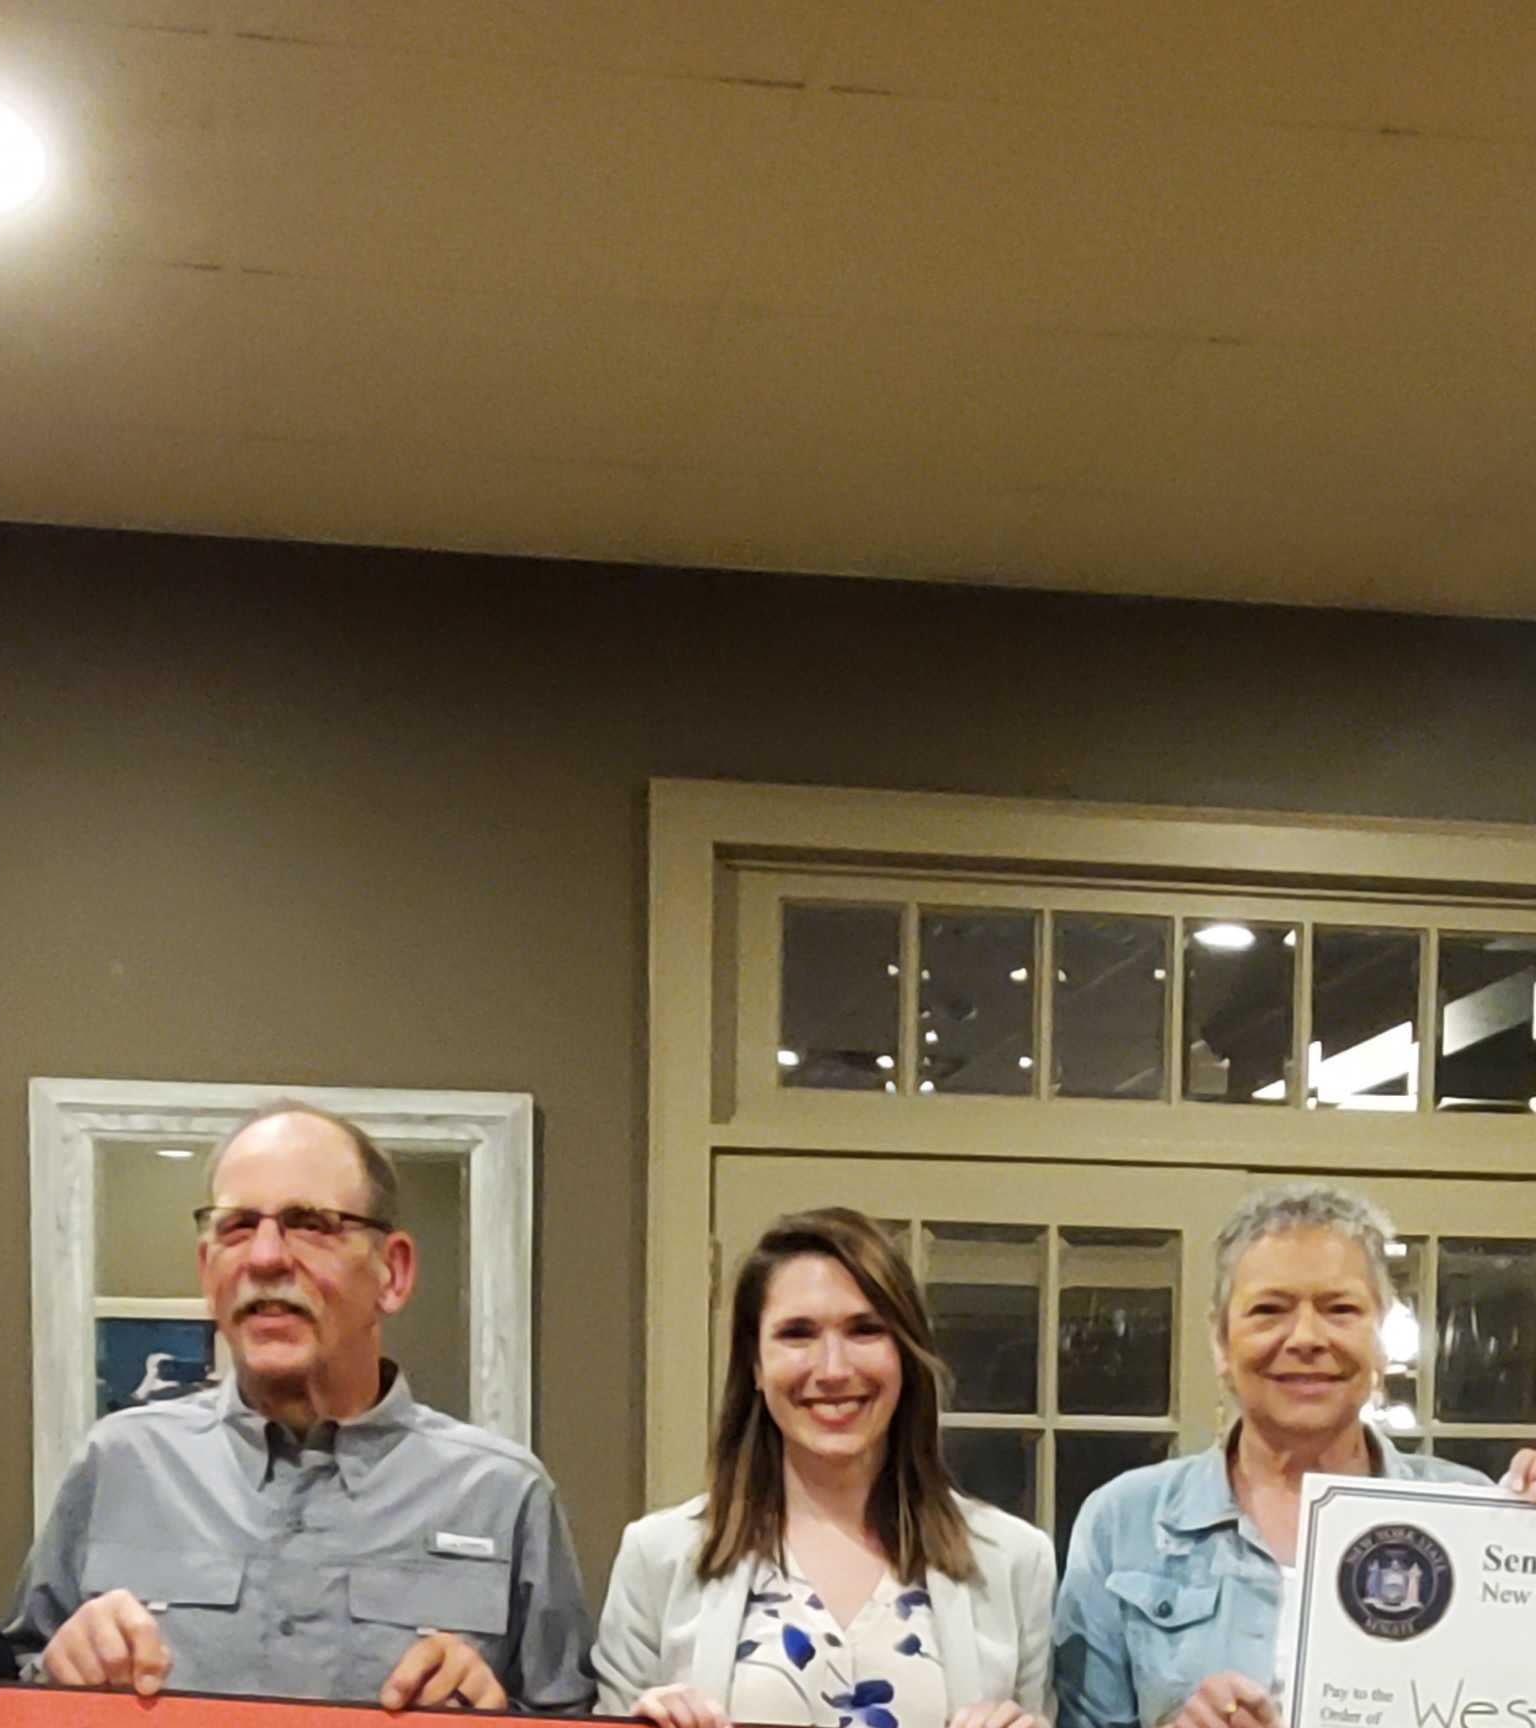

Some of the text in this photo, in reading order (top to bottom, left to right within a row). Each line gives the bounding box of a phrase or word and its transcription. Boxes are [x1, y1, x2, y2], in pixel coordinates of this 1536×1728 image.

[1481, 1582, 1532, 1605] New
[1323, 1683, 1348, 1702] Pay
[1320, 1706, 1361, 1723] Order
